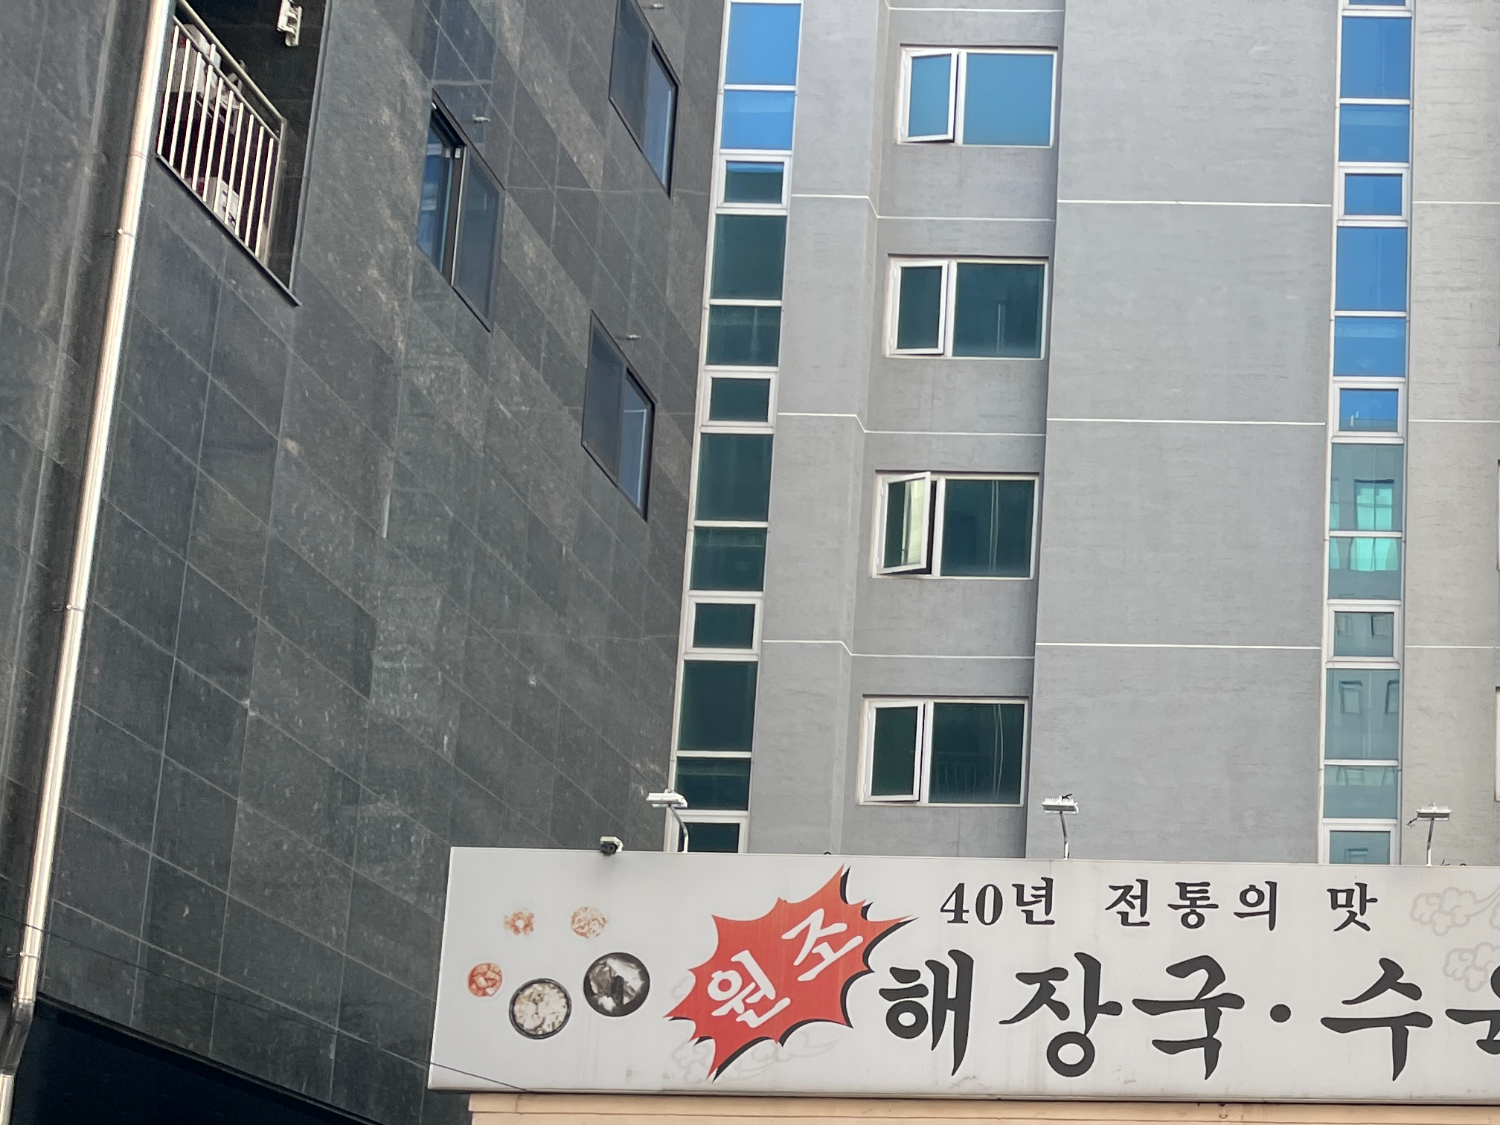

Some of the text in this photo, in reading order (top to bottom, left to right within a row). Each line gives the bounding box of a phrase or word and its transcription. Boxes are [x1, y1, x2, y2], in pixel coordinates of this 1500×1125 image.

[940, 876, 1378, 932] 40년 전통의 맛
[707, 908, 863, 1029] 원조
